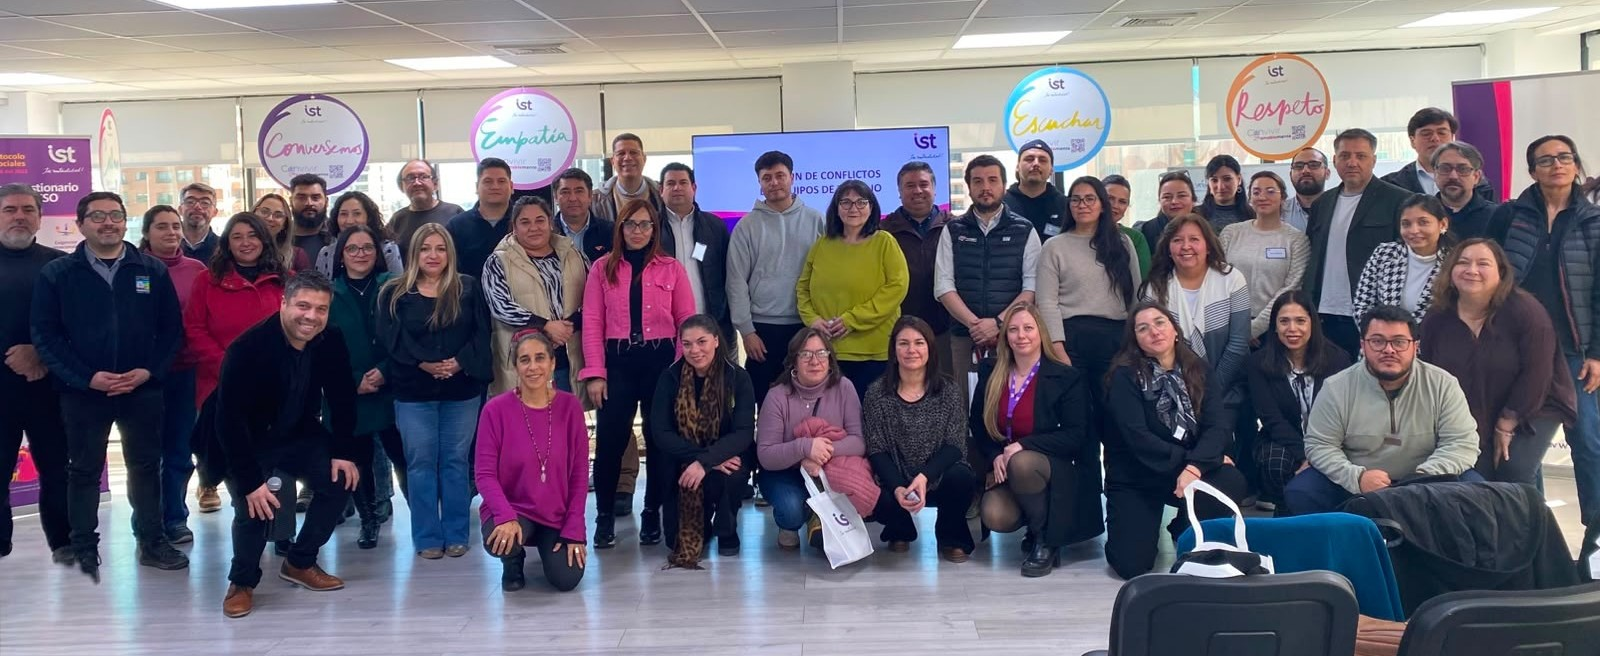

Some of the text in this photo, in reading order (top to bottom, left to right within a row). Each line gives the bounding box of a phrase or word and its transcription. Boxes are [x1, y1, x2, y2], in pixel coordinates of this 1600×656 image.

[1267, 65, 1284, 77] ist
[1048, 78, 1065, 90] ist
[516, 98, 533, 110] ist
[1235, 89, 1324, 127] Respeto
[304, 105, 322, 117] ist
[1013, 100, 1104, 136] Escuchar
[265, 132, 363, 158] Conversemos
[914, 133, 937, 149] ist
[48, 145, 76, 163] ist
[806, 171, 818, 180] DE
[821, 169, 881, 180] CONFLICTOS
[822, 185, 834, 194] DE
